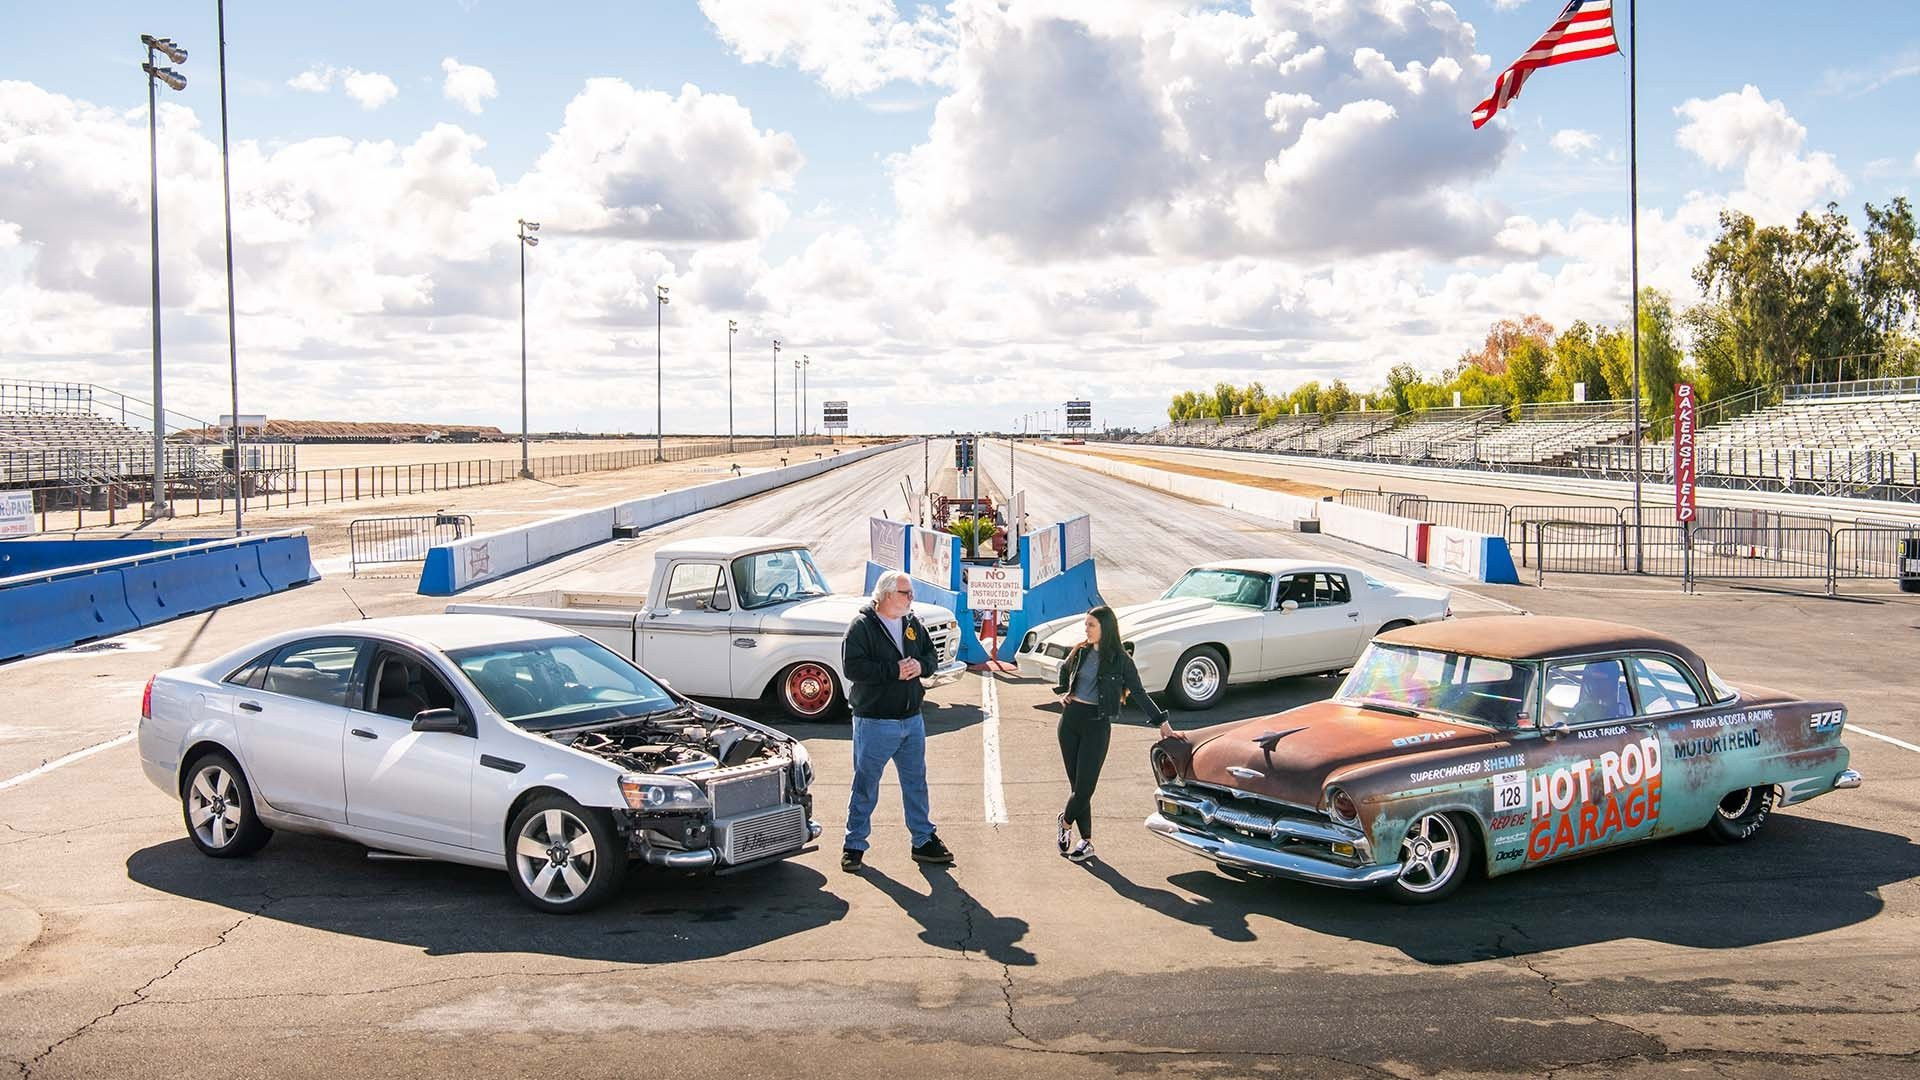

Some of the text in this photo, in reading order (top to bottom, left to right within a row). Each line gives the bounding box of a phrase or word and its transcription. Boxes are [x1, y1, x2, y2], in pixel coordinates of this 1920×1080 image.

[1678, 384, 1693, 520] BAKERSFIELD
[985, 570, 1006, 580] NO
[970, 581, 1020, 589] BURNOUTS UNTIL
[976, 598, 1013, 606] AN OFFICIAL
[1691, 717, 1718, 729] TAYLOR
[1747, 709, 1774, 722] RACING
[1809, 710, 1842, 728] 378
[1578, 726, 1628, 740] ALEX TAYLOR
[1674, 728, 1761, 759] MOTORTREND
[1410, 761, 1481, 783] SUPERCHARGED
[1490, 755, 1519, 771] HEMI
[1531, 736, 1661, 820] HOT ROD
[1500, 786, 1521, 808] 128
[1490, 812, 1528, 831] RED EYE
[1528, 780, 1661, 861] GARAGE
[1496, 848, 1524, 861] Dodge
